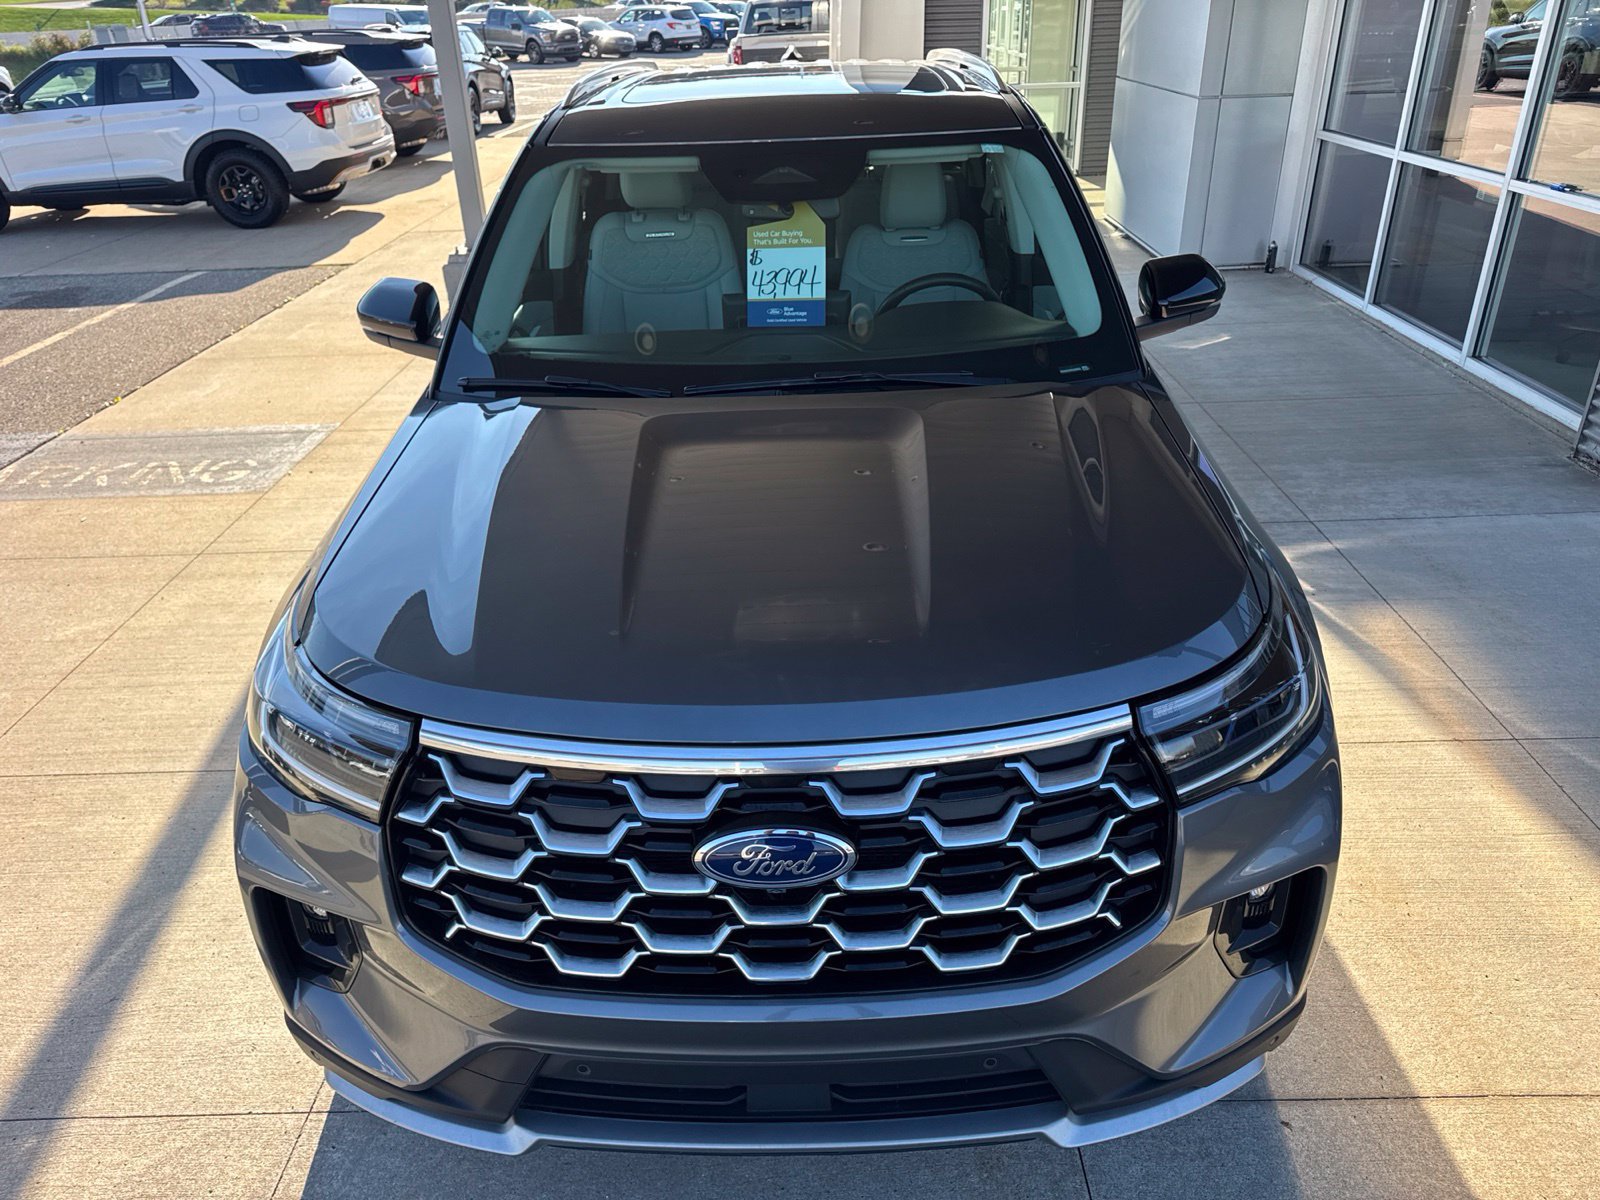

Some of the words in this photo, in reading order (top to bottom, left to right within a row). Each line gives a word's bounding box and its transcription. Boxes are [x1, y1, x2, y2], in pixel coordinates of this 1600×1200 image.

[753, 230, 769, 238] Used
[781, 229, 803, 237] Buying
[772, 237, 787, 245] Built
[750, 248, 763, 266] $
[732, 844, 818, 876] Ford
